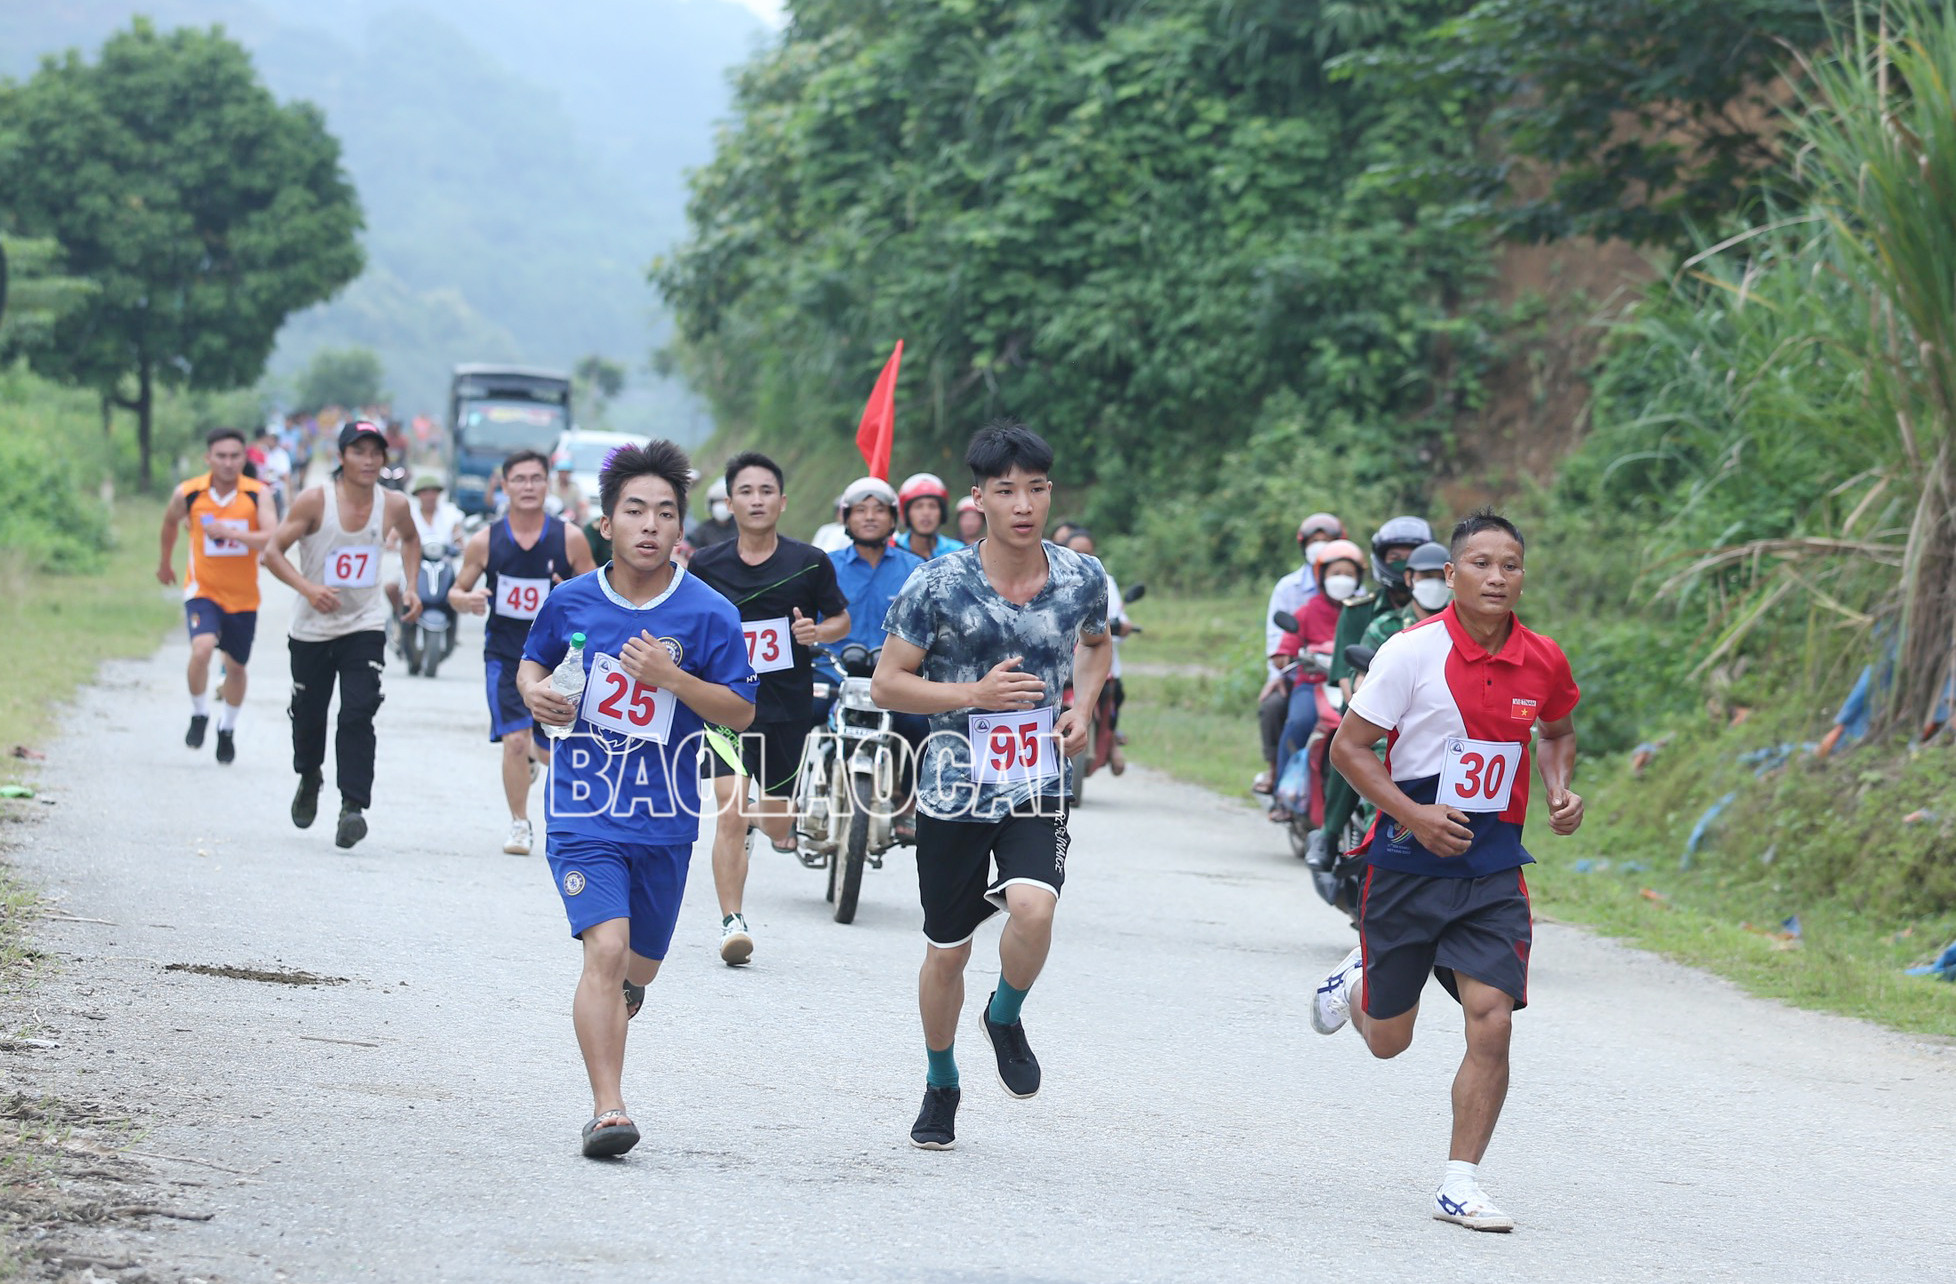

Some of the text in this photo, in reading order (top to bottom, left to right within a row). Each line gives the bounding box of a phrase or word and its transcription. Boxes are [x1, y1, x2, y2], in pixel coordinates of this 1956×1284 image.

[336, 554, 368, 580] 67
[507, 587, 539, 611] 49
[744, 629, 779, 665] 73
[598, 672, 656, 726] 25
[990, 722, 1039, 771] 95
[1455, 752, 1505, 799] 30
